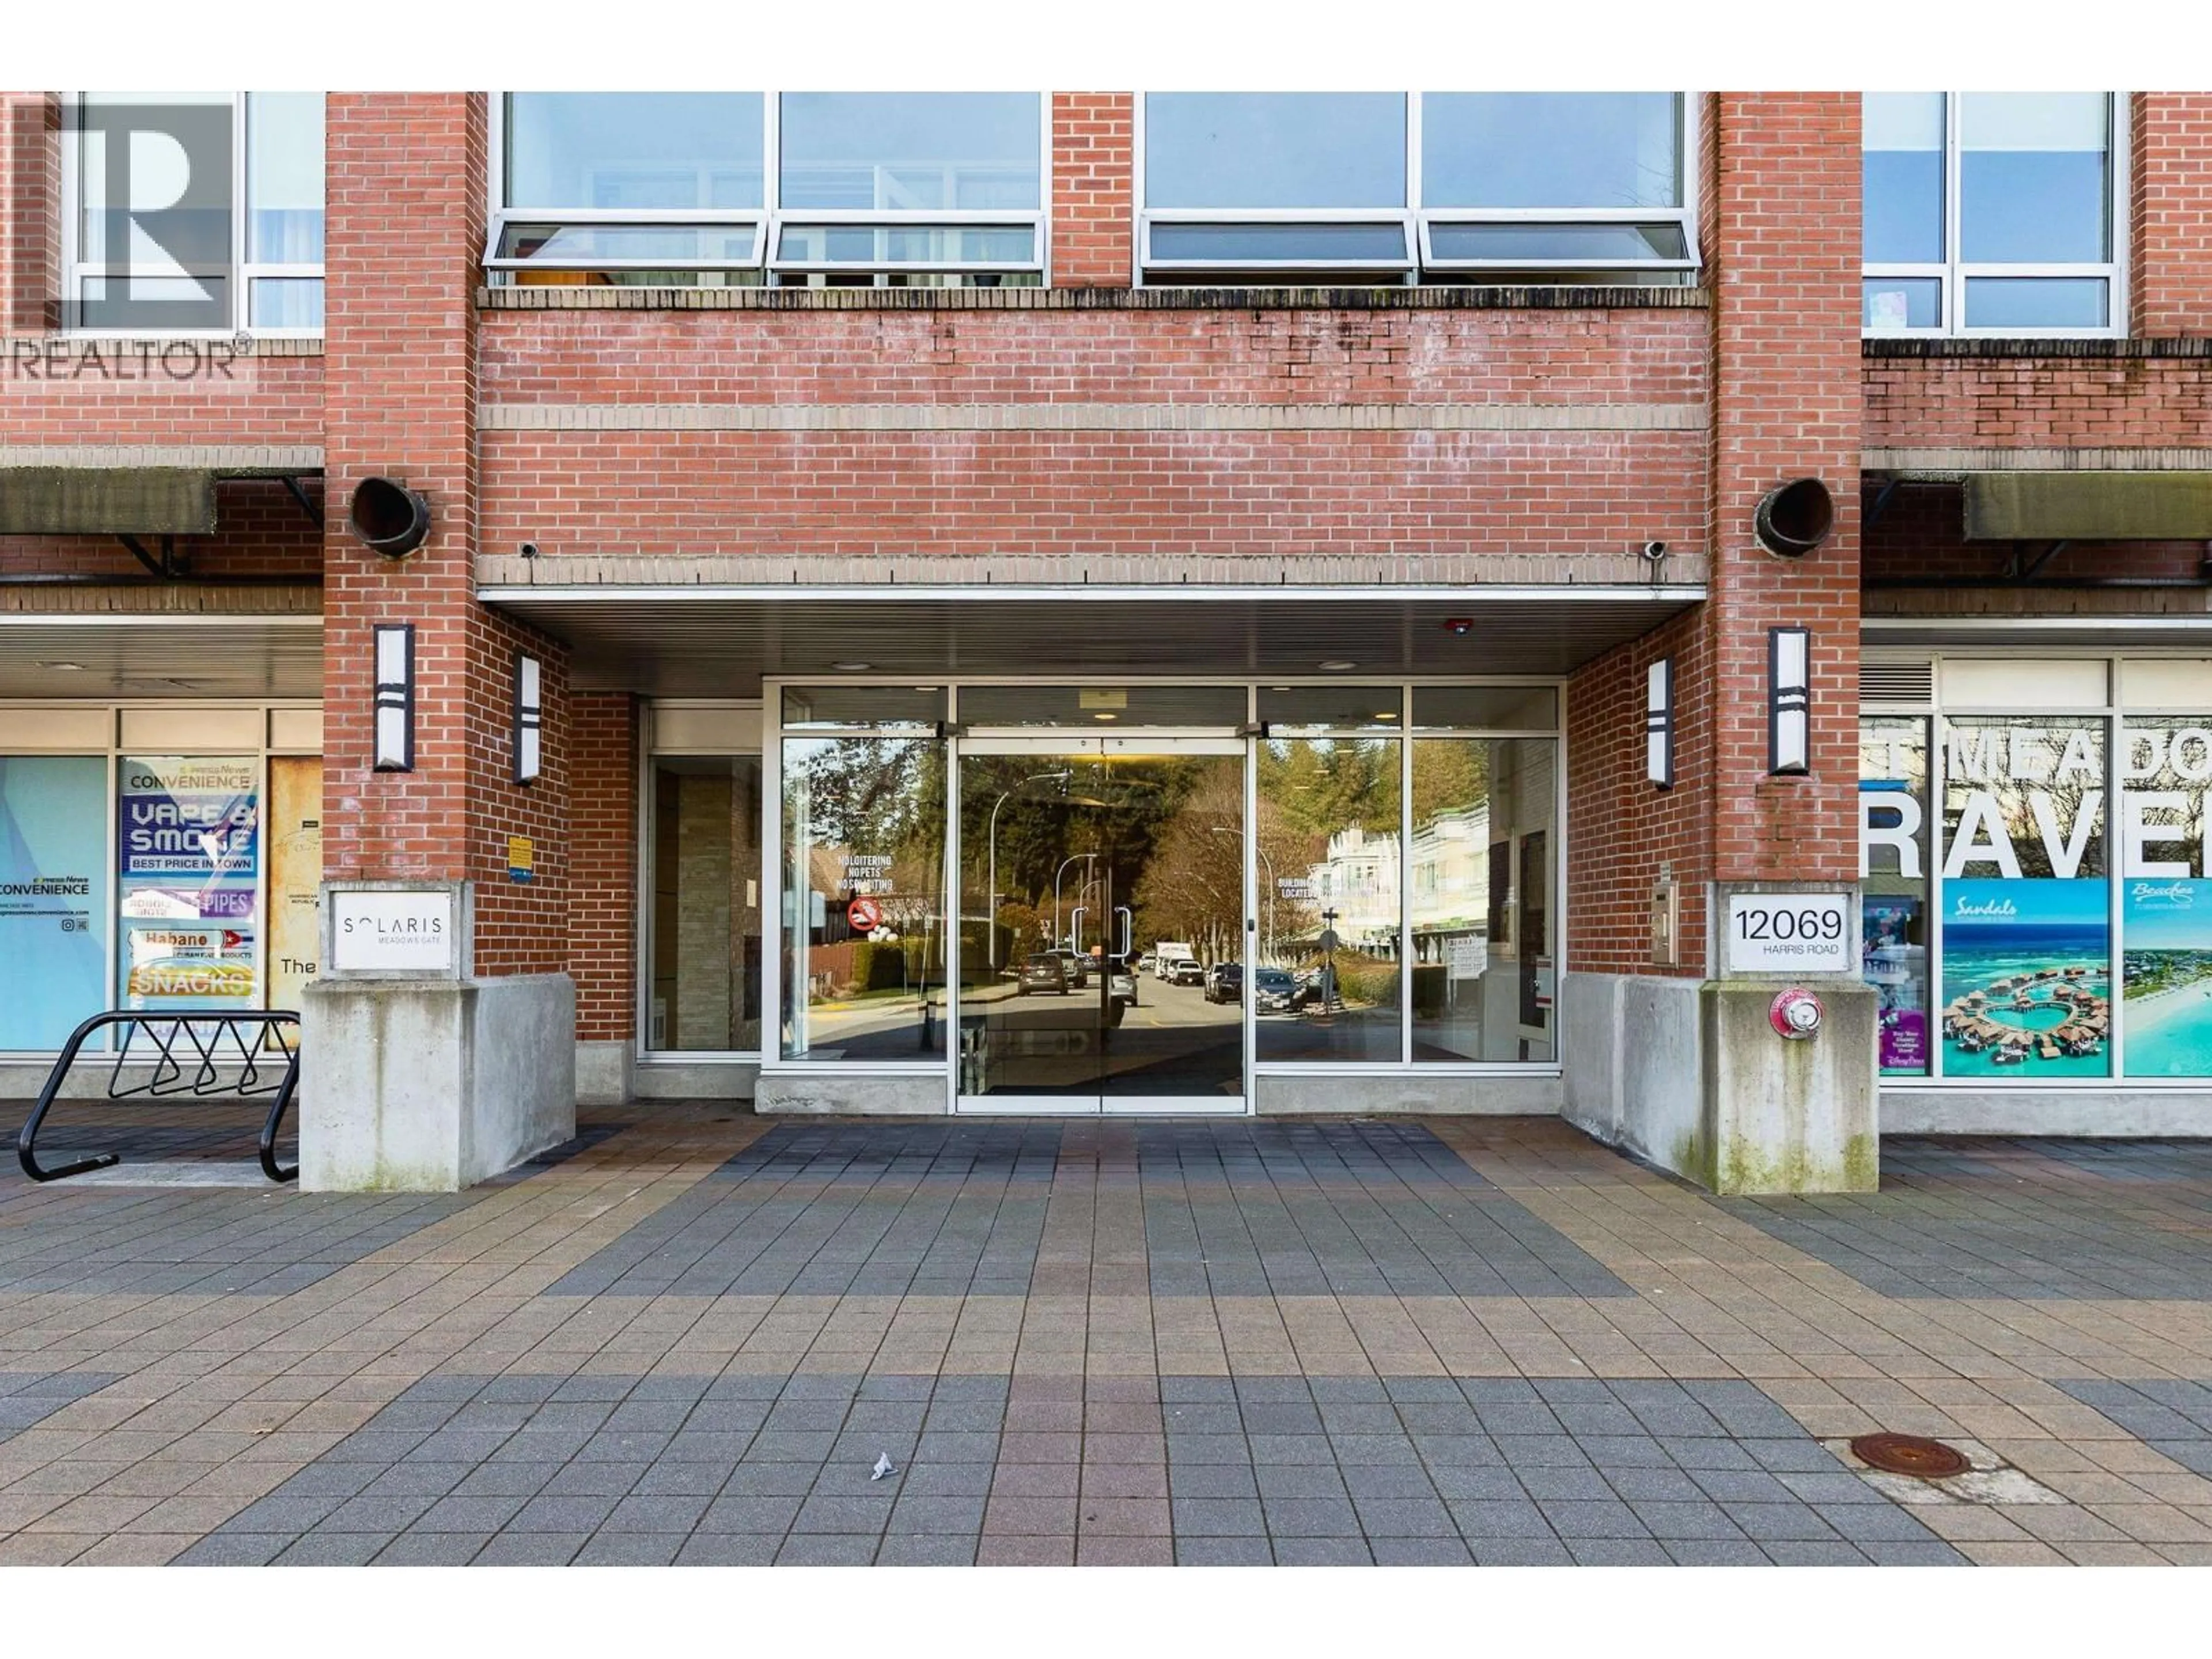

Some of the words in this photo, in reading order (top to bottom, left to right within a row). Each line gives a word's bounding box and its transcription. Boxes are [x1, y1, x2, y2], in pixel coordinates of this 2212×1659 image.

[131, 776, 249, 789] CONVENIENCE
[132, 803, 223, 826] VAPE
[1859, 791, 2212, 878] RAVE
[132, 859, 160, 868] BEST
[165, 859, 199, 868] PRICE
[202, 859, 213, 868] IN
[850, 855, 891, 866] LOITERING
[849, 867, 859, 877] NO
[860, 867, 880, 877] PETS
[0, 884, 89, 895] ONVENIENCE
[849, 879, 893, 891] SOITING
[1955, 896, 2017, 916] Sandals
[344, 918, 442, 933] SOLARIS
[1736, 910, 1842, 940] 12069
[1763, 944, 1805, 955] HARRIS
[1807, 944, 1839, 955] ROAD
[281, 959, 316, 974] The
[137, 973, 244, 994] SNACKS
